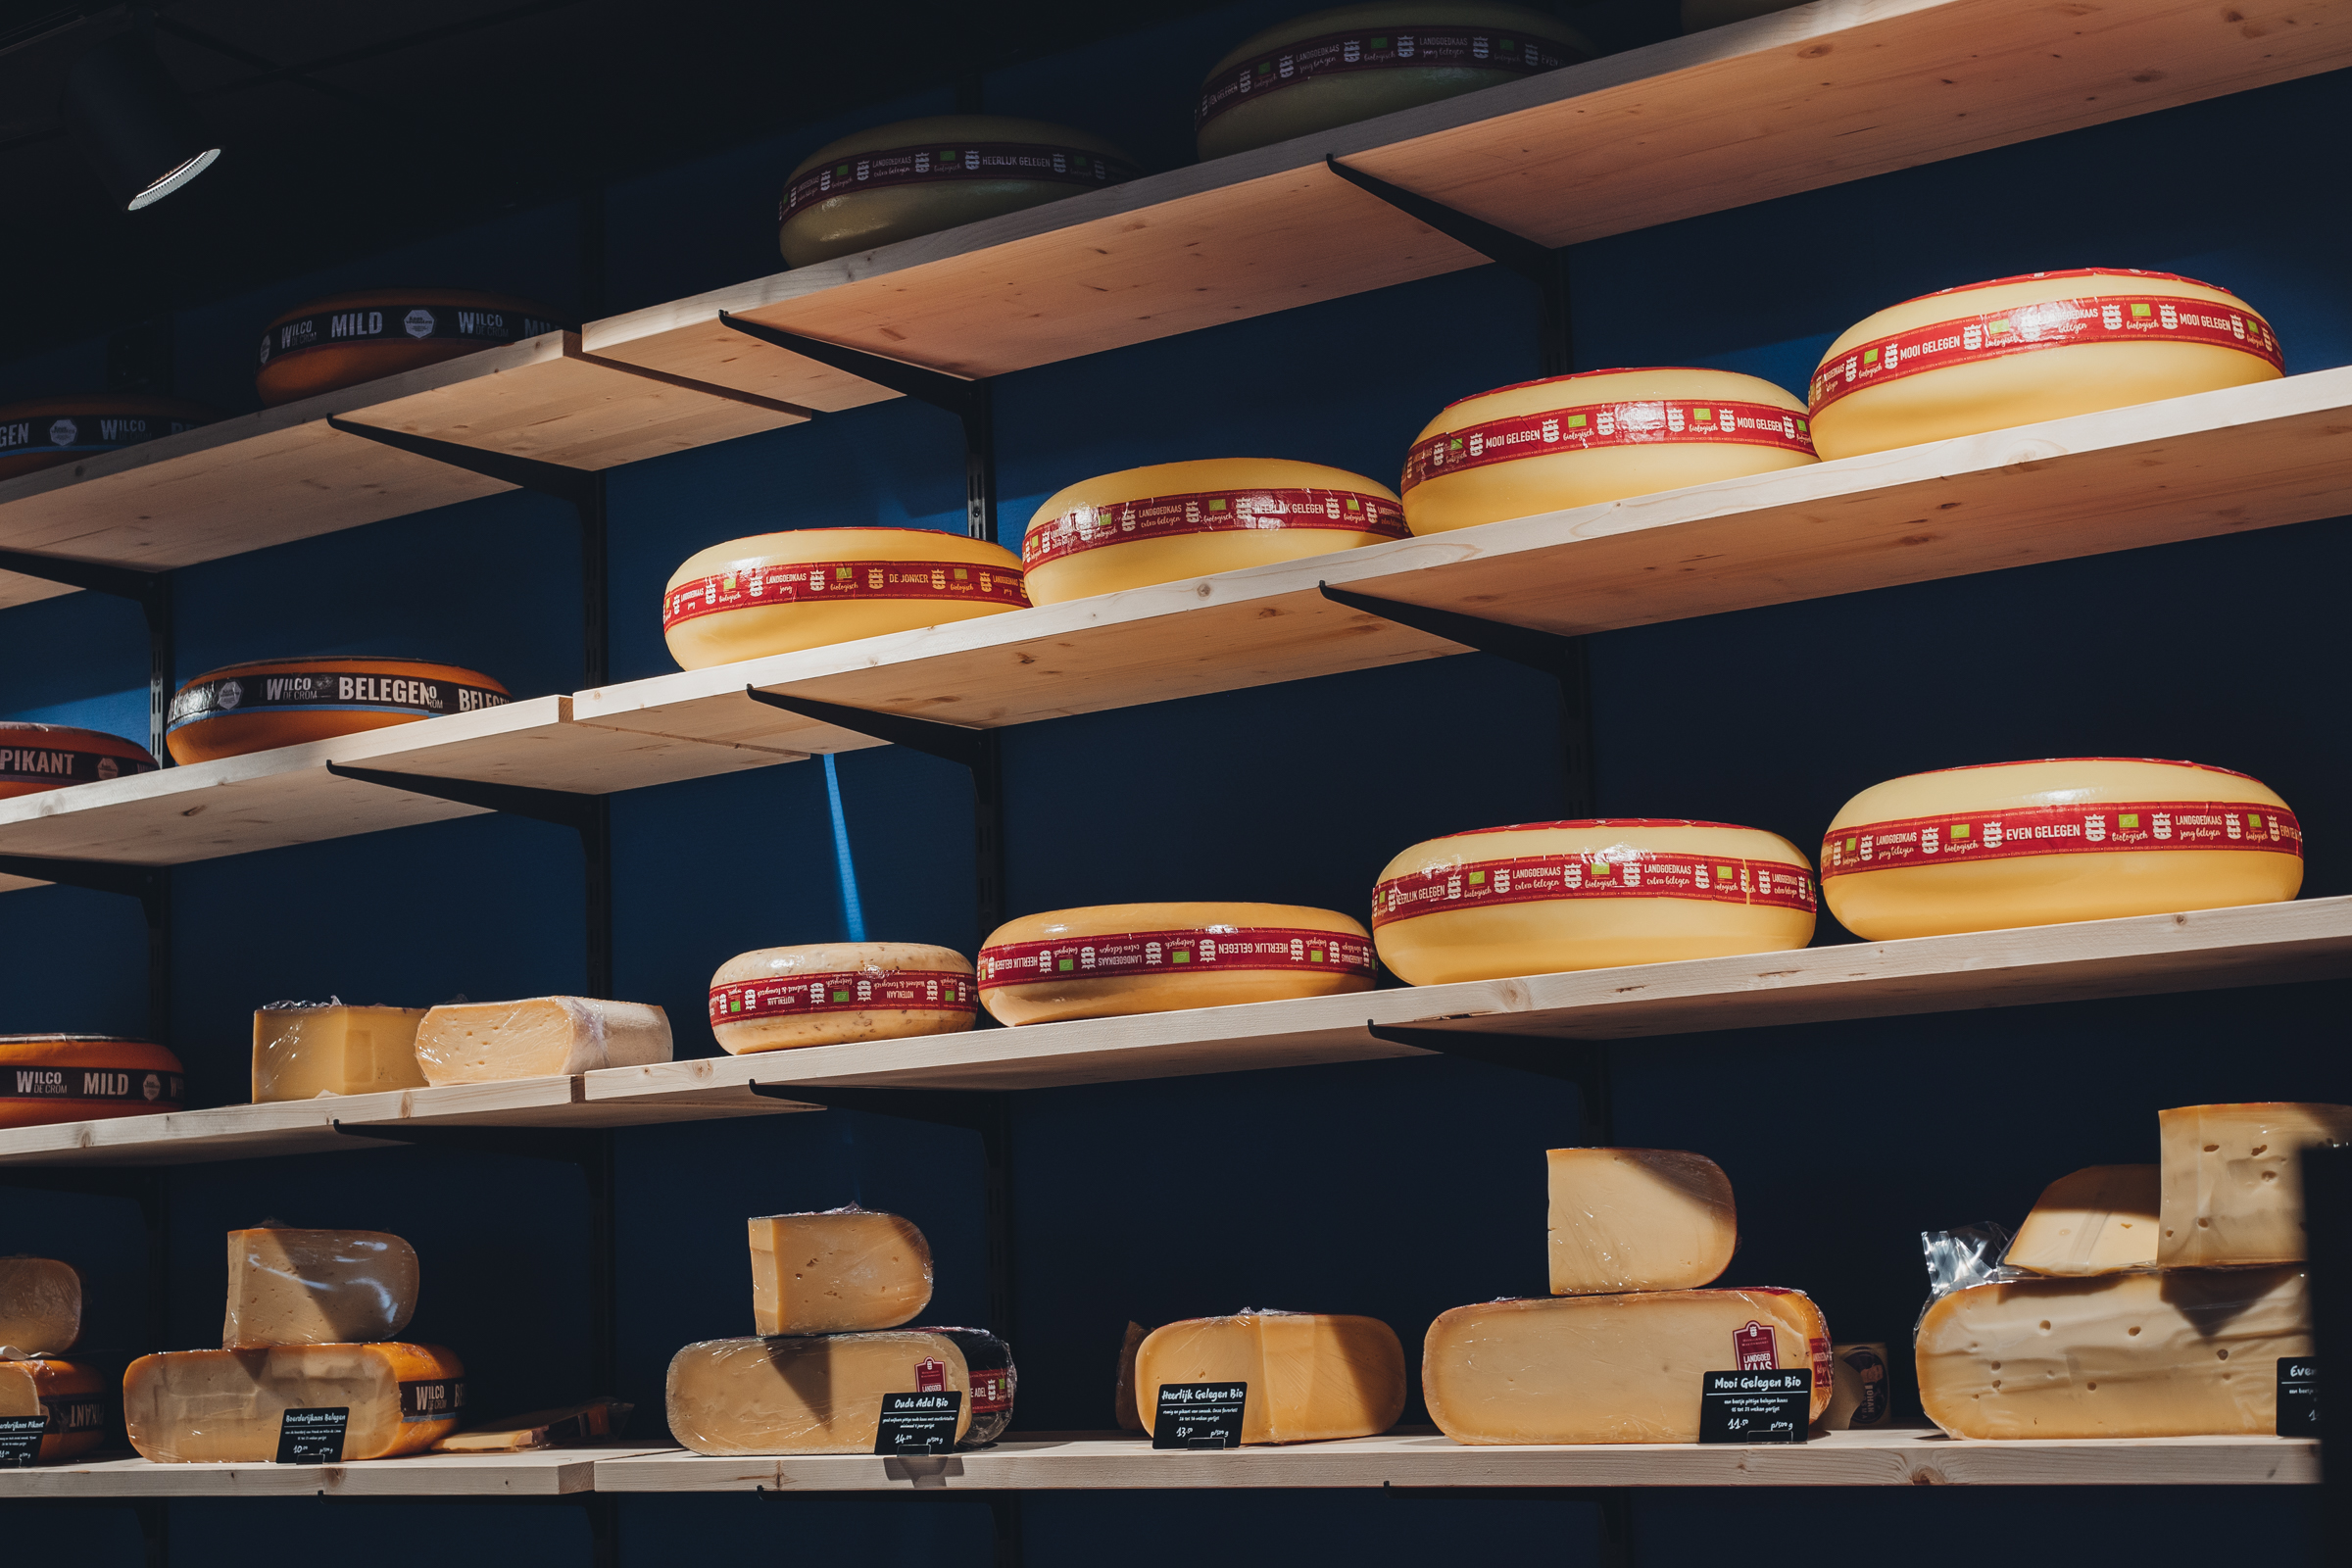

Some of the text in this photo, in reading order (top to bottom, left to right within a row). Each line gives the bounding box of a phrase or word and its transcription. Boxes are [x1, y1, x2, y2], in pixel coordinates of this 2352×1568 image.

[1419, 37, 1468, 46] LANDGOEDKAAS
[1296, 44, 1341, 63] LANDGOEDKAAS
[1363, 51, 1396, 63] biologisch
[872, 156, 912, 170] LANDGOEDKAAS
[982, 156, 1051, 168] HEERLIJK GELEGEN
[331, 311, 383, 339] MILD
[458, 311, 504, 334] WILCO
[2058, 321, 2087, 334] belegen
[2126, 319, 2160, 333] biologisch
[2180, 312, 2231, 331] MOOI GELEGEN
[281, 319, 313, 349] WILCO
[1984, 332, 2021, 349] biologisch
[1899, 335, 1961, 361] MOOI GELEGEN
[1858, 364, 1883, 379] biologisch
[100, 418, 146, 441] WILCO
[1689, 420, 1719, 435] biologisch
[1736, 416, 1784, 432] MOOI GELEGEN
[1486, 429, 1541, 450] MOOI GELEGEN
[1562, 427, 1594, 442] biologisch
[1138, 505, 1182, 518] LANDGOEDKAAS
[1292, 503, 1325, 515] GELEGEN
[1156, 514, 1181, 529] belegen
[1203, 512, 1234, 525] biologisch
[765, 572, 808, 585] LANDGOEDKAAS
[889, 573, 929, 584] DE JONKER
[830, 580, 858, 594] biologisch
[950, 581, 974, 594] biologisch
[718, 591, 742, 604] biologisch
[267, 677, 312, 701] WILCO
[283, 690, 318, 701] DE CROM
[338, 676, 430, 706] BELEGEN
[0, 749, 74, 775] PIKANT
[2176, 814, 2223, 827] LANDGOEDKAAS
[1876, 832, 1918, 846] LANDGOEDKAAS
[2006, 823, 2081, 842] EVEN GELEGEN
[2111, 830, 2149, 844] biologisch
[2180, 826, 2222, 841] jong belegen
[1890, 845, 1915, 858] belegen
[1943, 840, 1981, 855] biologisch
[1512, 866, 1561, 880] LANDGOEDKAAS
[1643, 862, 1691, 875] LANDGOEDKAAS
[1514, 877, 1560, 891] extra belegen
[1585, 877, 1618, 891] biologisch
[1646, 874, 1690, 887] extra belegen
[1418, 885, 1446, 901] GELEGEN
[1463, 885, 1493, 900] biologisch
[1164, 937, 1196, 950] biologisch
[1218, 943, 1289, 955] HEERLIJK GELEGEN
[1054, 946, 1078, 957] biologisch
[1013, 956, 1039, 969] HEERLIJK
[1098, 955, 1143, 966] LANDGOEDKAAS
[767, 995, 795, 1006] NOTENLAAN
[886, 990, 914, 1000] NOTENLAAN
[16, 1071, 63, 1094] WILCO
[33, 1084, 68, 1094] DE CROM
[83, 1072, 129, 1096] MILD
[1743, 1352, 1771, 1364] LANDGOED
[1744, 1361, 1773, 1371] KAAS
[1714, 1375, 1802, 1392] Mooi Gelegen Bio
[416, 1385, 445, 1411] WILCO
[973, 1387, 987, 1397] ADEL
[1161, 1388, 1244, 1403] Heerlijk Gelegen Bio
[894, 1396, 949, 1409] Oude Adel Bio
[324, 1412, 346, 1424] Belegen
[1788, 1422, 1793, 1431] g
